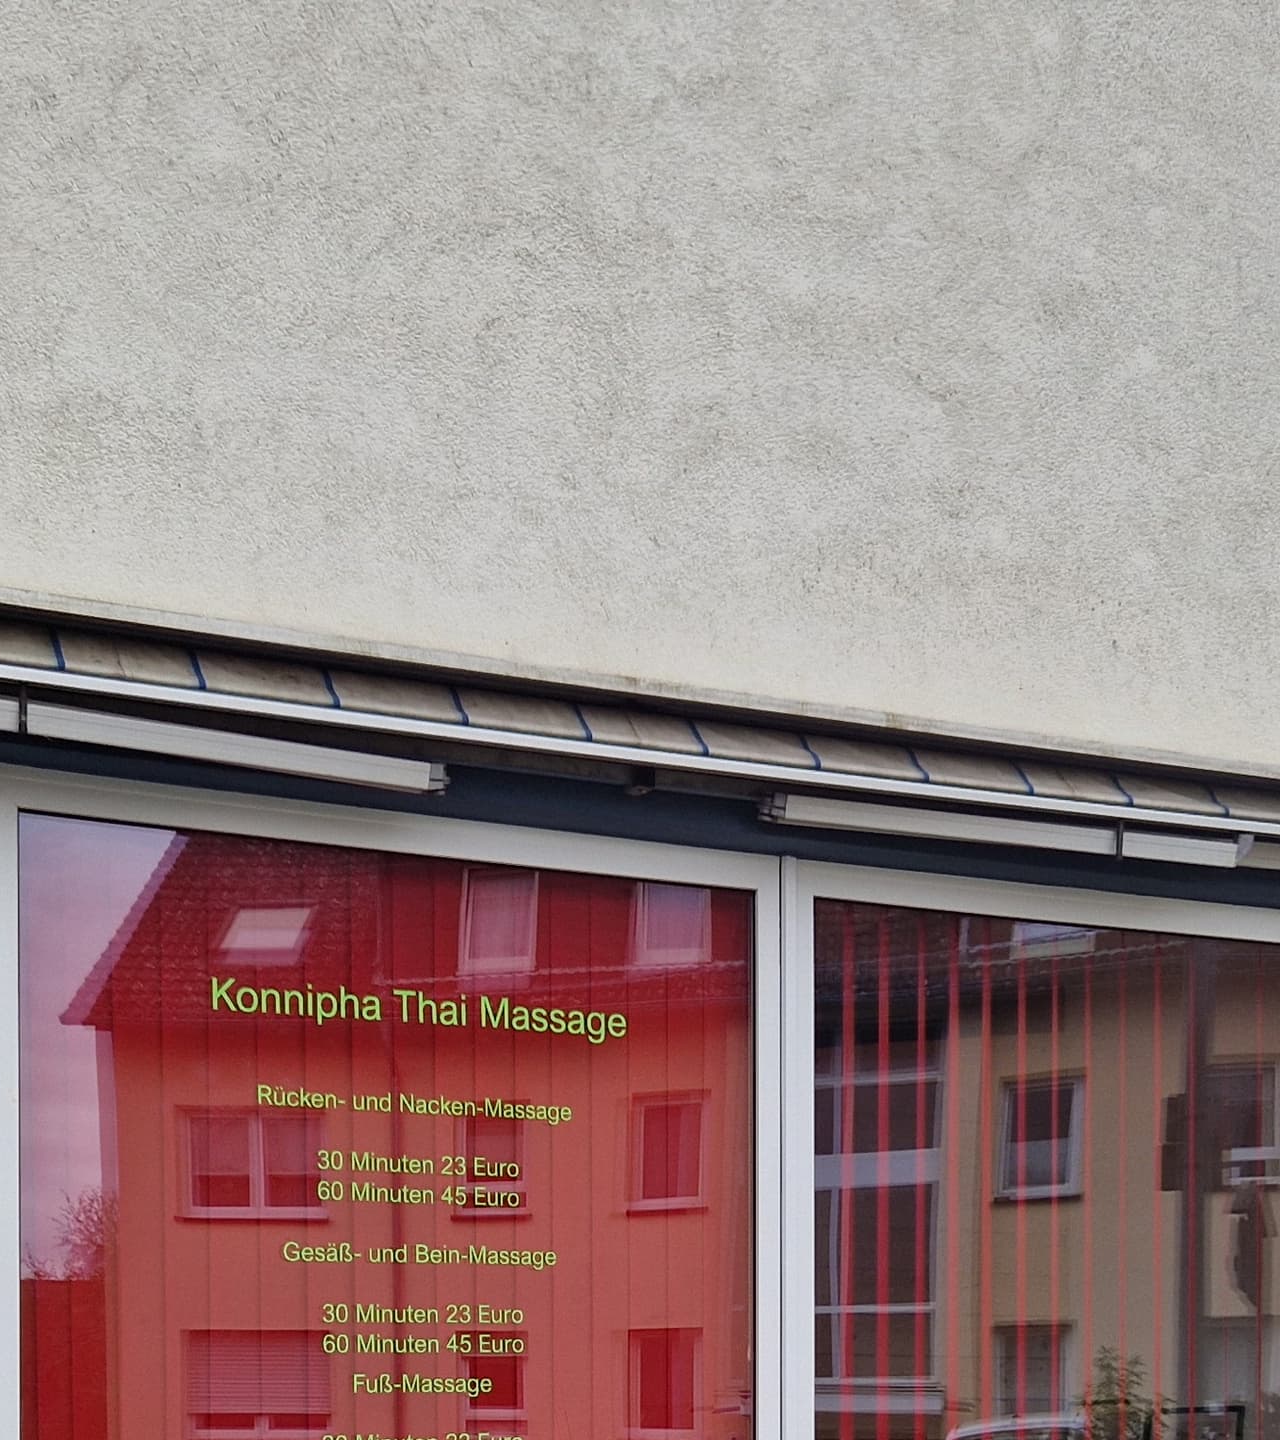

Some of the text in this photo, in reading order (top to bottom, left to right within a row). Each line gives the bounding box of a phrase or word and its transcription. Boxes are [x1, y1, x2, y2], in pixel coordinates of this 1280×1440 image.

[212, 977, 627, 1044] Konnipha Thai Massage
[257, 1084, 572, 1125] Rücken- und Nacken-Massage
[318, 1150, 519, 1177] 30 Minuten 23 Euro
[317, 1180, 519, 1207] 60 Minuten 45 Euro
[283, 1241, 557, 1271] Gesäß- und Bein-Massage
[322, 1303, 524, 1324] 30 Minuten 23 Euro
[323, 1334, 524, 1354] 60 Minuten 45 Euro
[353, 1373, 492, 1397] Fuß-Massage
